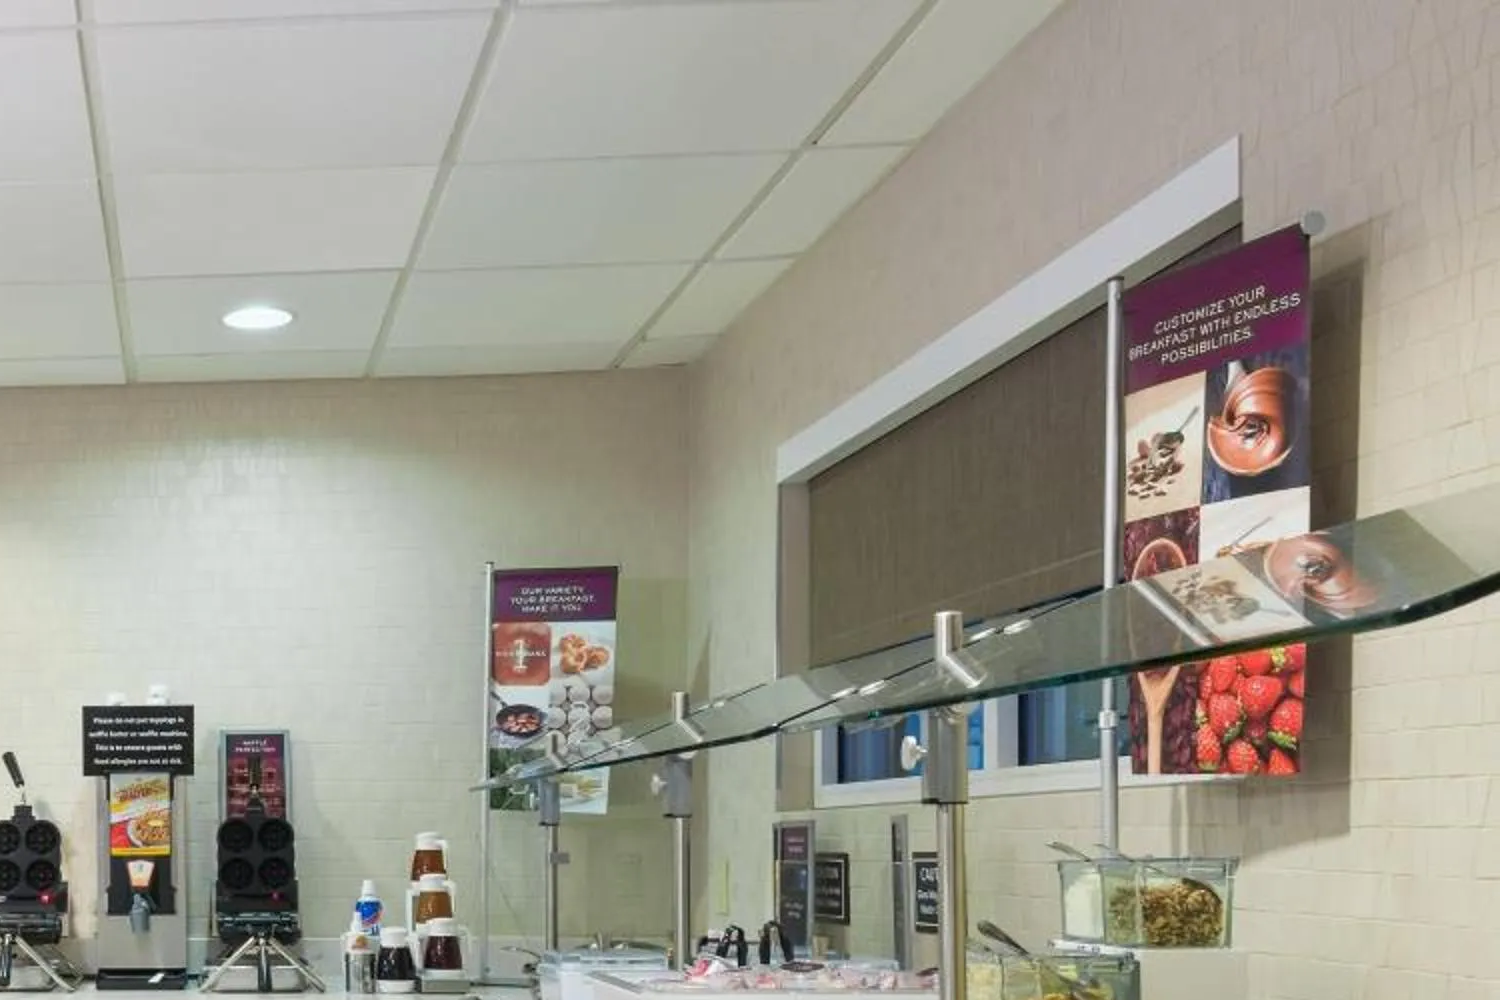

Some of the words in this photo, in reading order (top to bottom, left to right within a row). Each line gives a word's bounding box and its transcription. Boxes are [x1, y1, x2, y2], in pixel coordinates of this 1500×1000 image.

[1128, 326, 1196, 361] BREAKFAST
[1199, 315, 1231, 336] WITH
[1233, 292, 1301, 326] ENDLESS
[1154, 299, 1225, 335] CUSTOMIZE
[1227, 284, 1266, 308] YOUR
